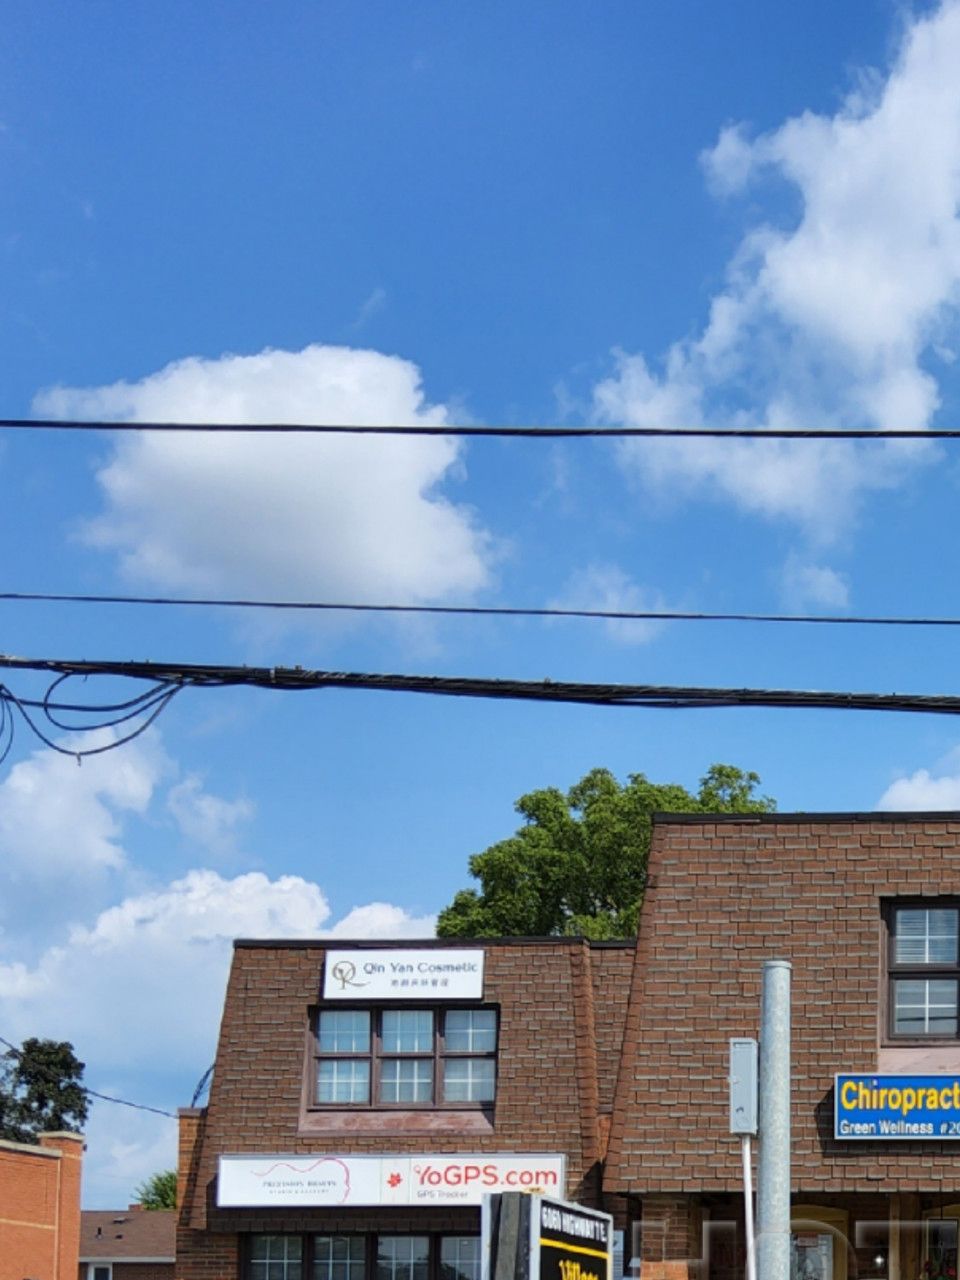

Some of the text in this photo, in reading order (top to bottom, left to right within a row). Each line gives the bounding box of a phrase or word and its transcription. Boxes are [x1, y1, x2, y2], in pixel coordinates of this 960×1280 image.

[363, 962, 478, 974] Qin Yan Cosmetic
[840, 1120, 876, 1134] Green
[879, 1120, 934, 1134] Wellness
[413, 1164, 557, 1186] YoGPS.com
